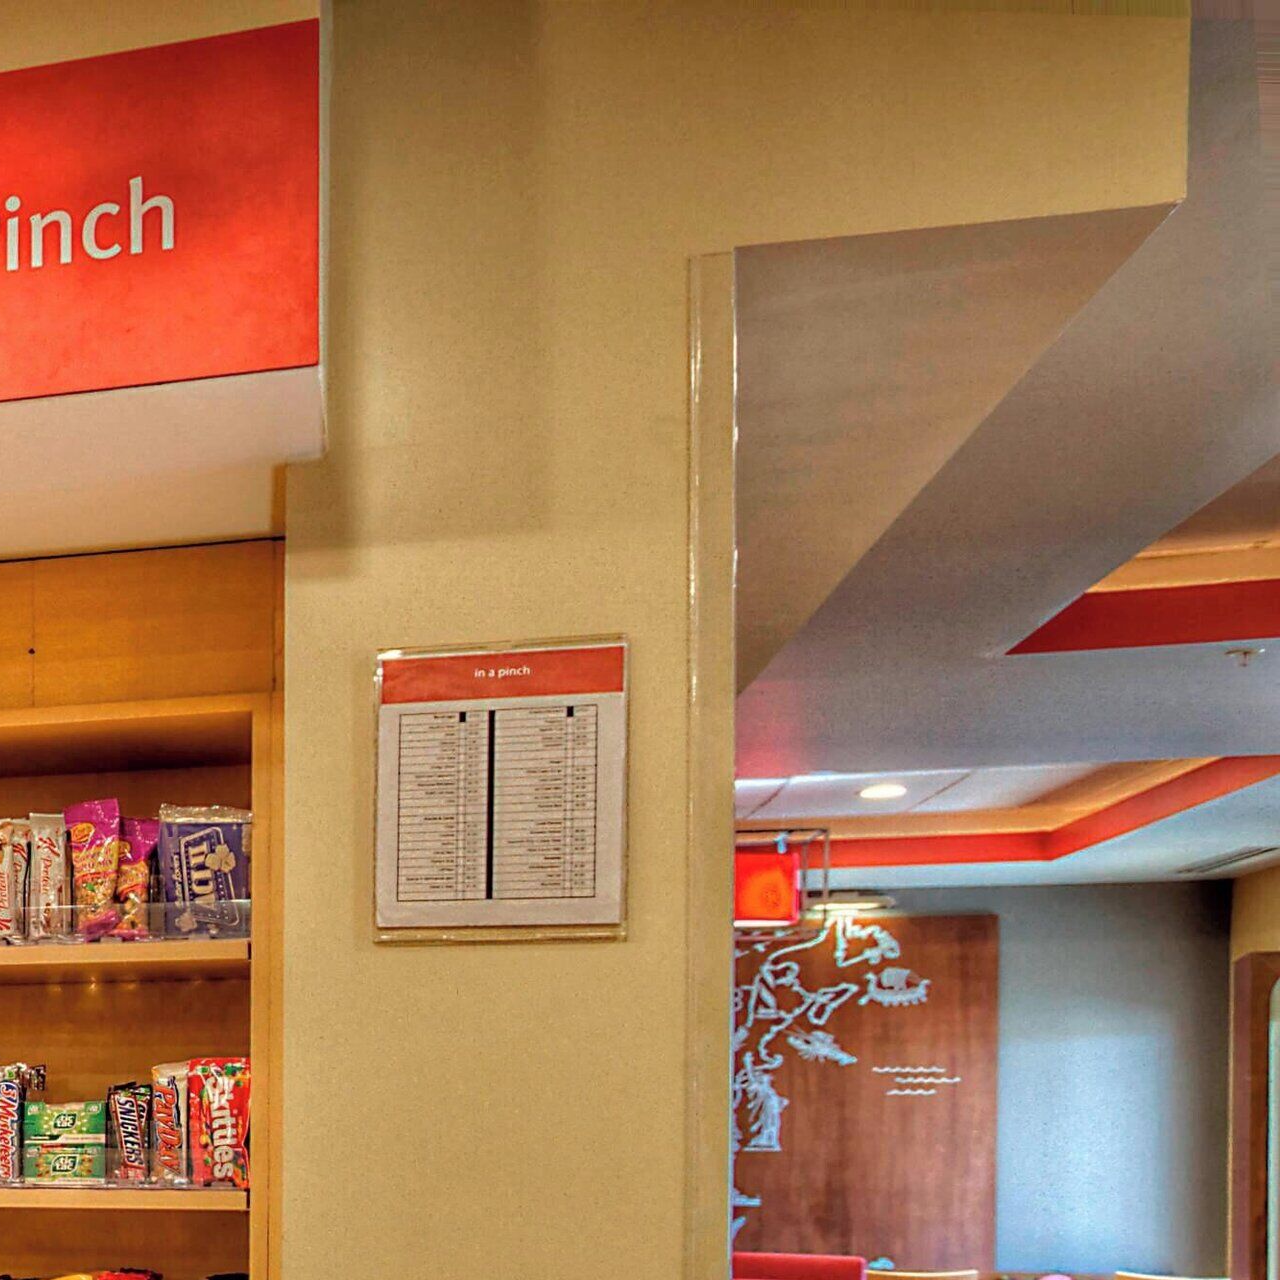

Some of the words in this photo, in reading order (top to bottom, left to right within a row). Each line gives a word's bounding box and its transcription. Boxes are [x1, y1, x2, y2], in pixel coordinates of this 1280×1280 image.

[474, 669, 485, 678] in
[488, 669, 496, 677] a
[498, 666, 530, 678] pinch
[42, 857, 53, 893] Protein
[57, 1113, 70, 1121] tic
[56, 1120, 73, 1128] tac
[206, 1077, 235, 1179] Skittles
[118, 1098, 145, 1166] SNICKERS
[58, 1155, 71, 1164] tic
[55, 1163, 74, 1172] tac
